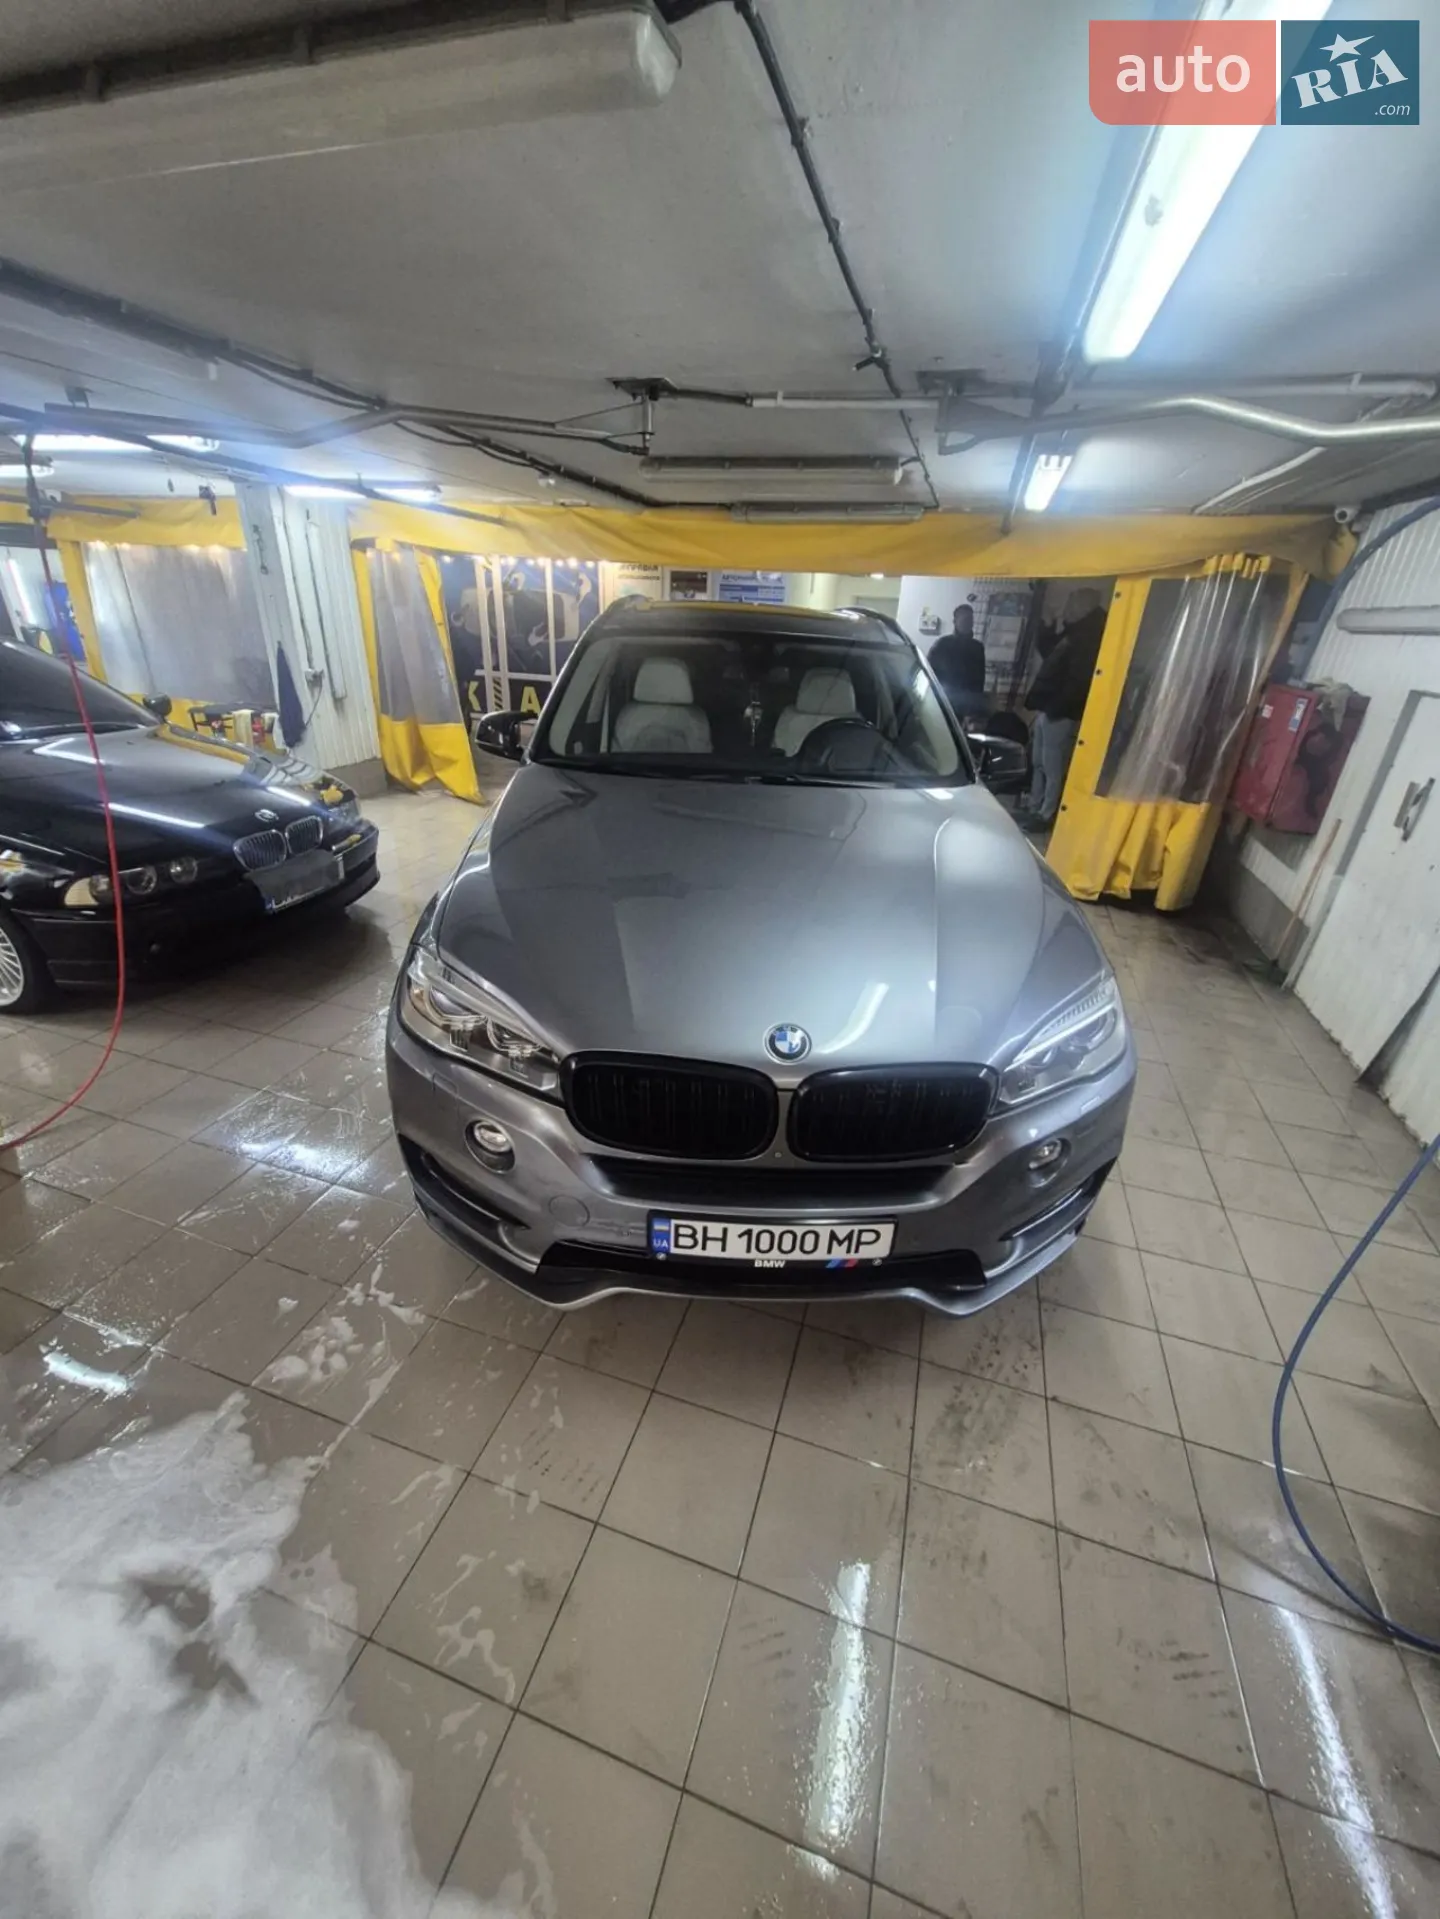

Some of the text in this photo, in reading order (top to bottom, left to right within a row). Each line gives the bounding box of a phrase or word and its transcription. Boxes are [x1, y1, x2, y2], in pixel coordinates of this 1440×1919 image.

[653, 1238, 669, 1250] UA
[673, 1223, 881, 1255] BH 1000 MP
[755, 1259, 785, 1269] BMW
